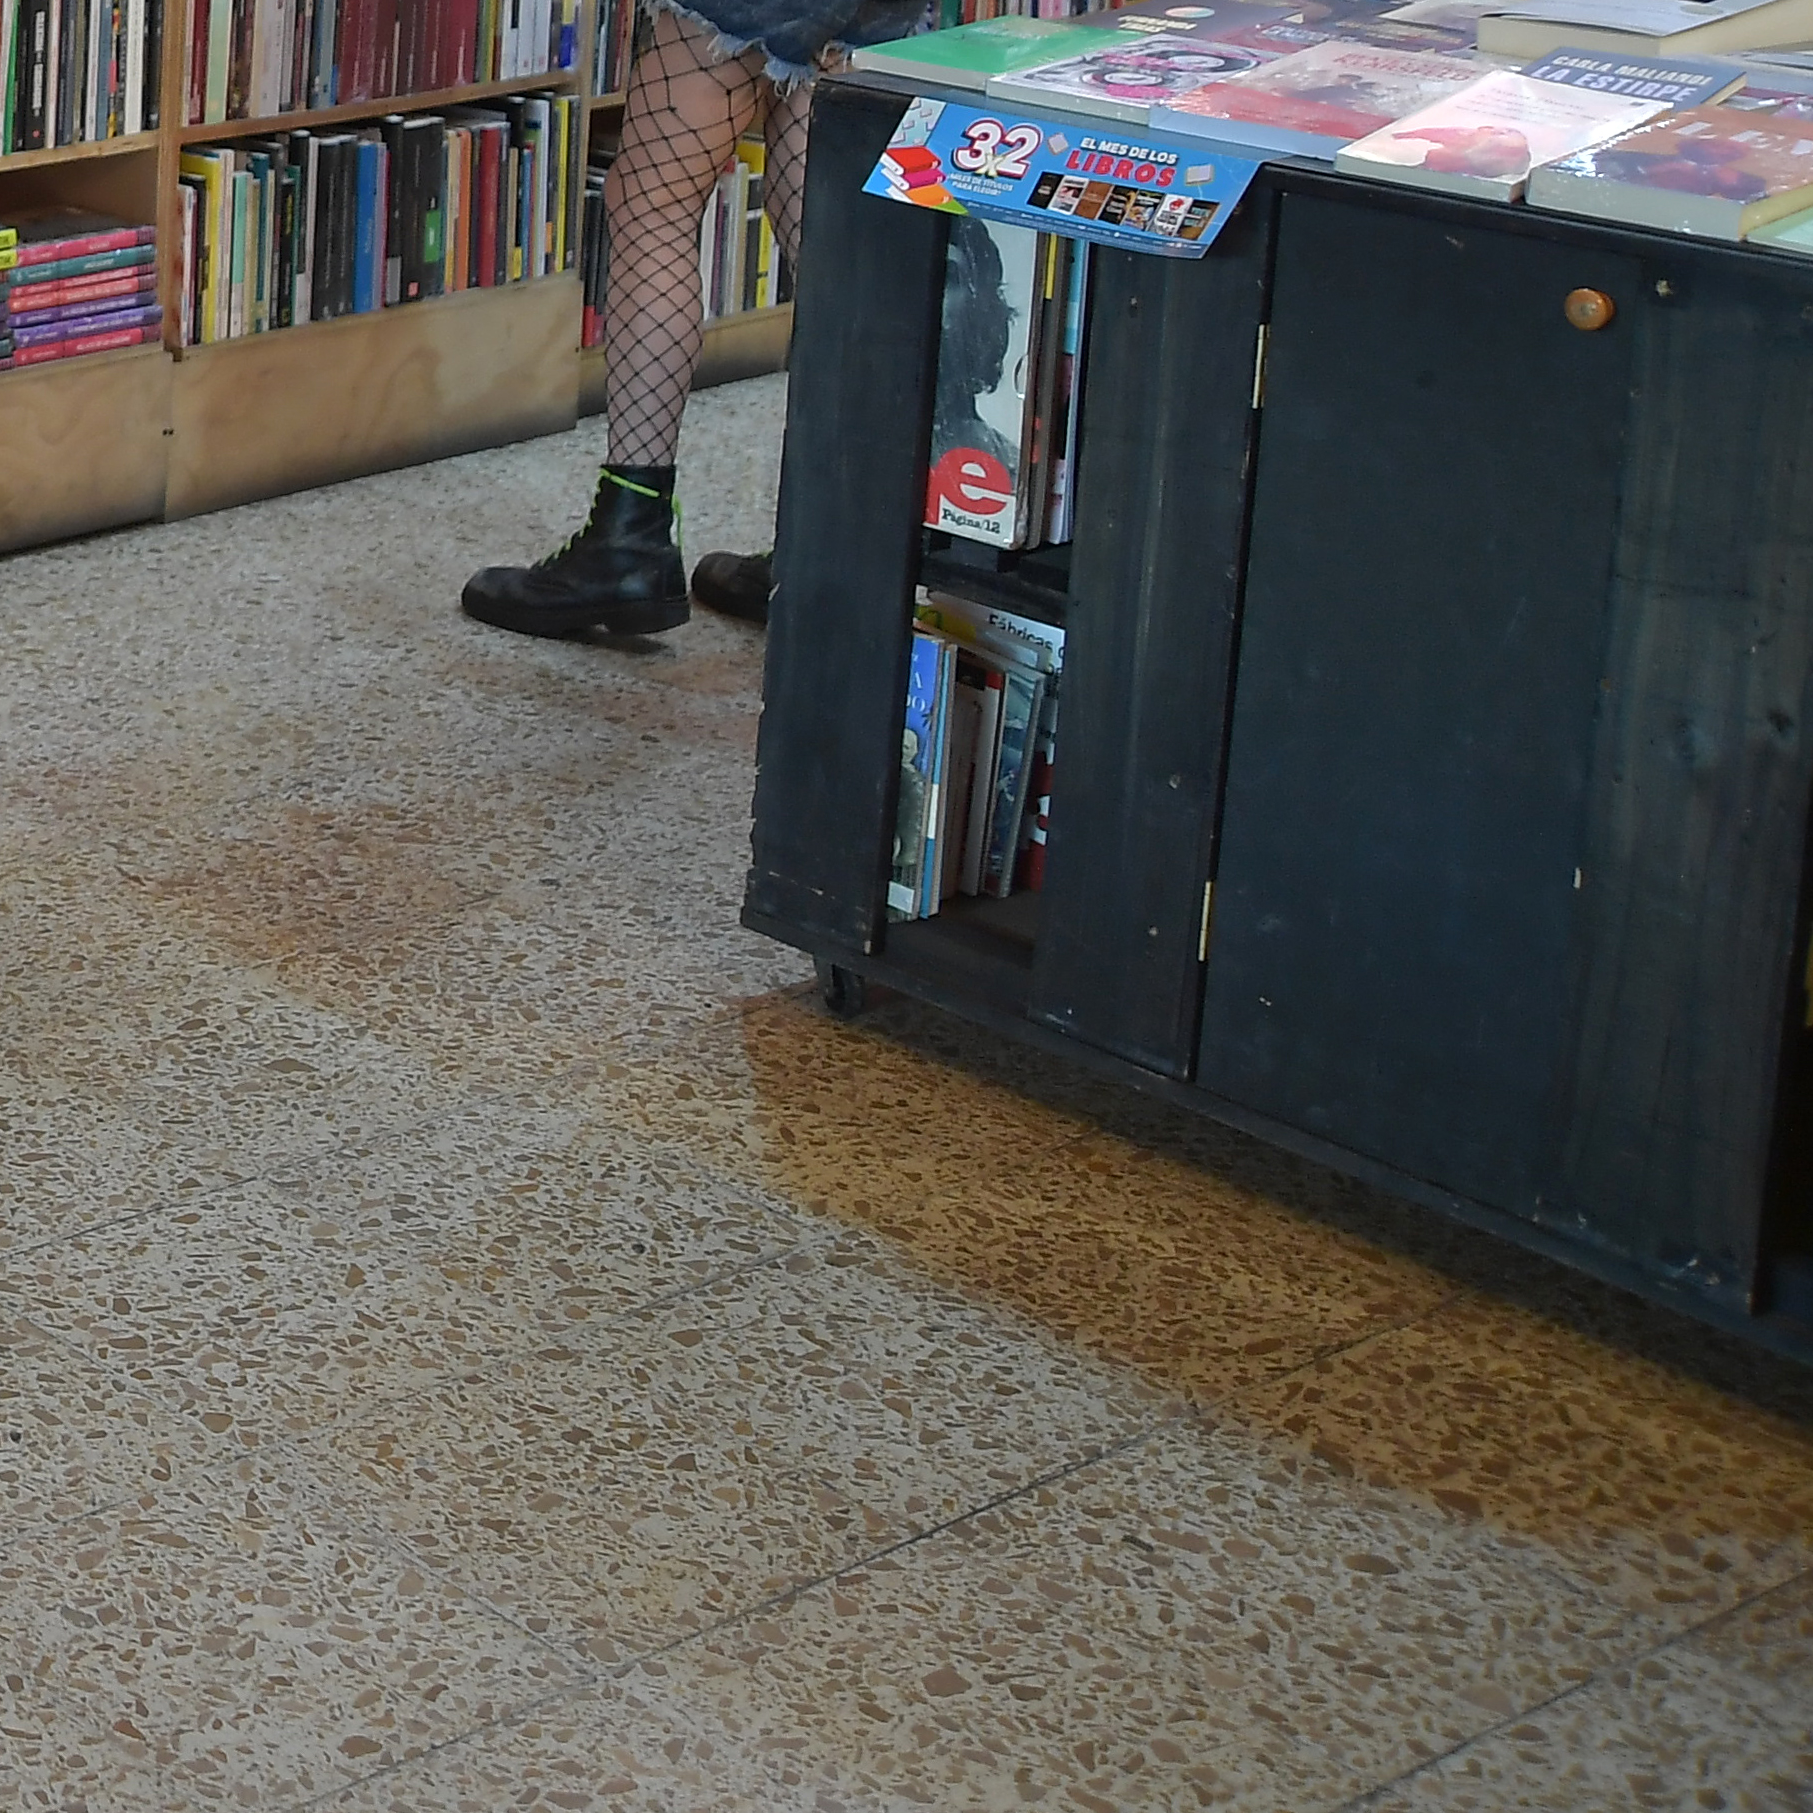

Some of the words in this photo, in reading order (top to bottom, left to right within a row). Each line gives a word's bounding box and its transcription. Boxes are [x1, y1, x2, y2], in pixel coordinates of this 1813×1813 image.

[1529, 65, 1568, 84] LA
[1573, 69, 1698, 103] ESTIRPE
[1552, 55, 1614, 76] CARLA
[1065, 150, 1176, 187] LIBROS
[1080, 138, 1097, 150] EL
[1098, 141, 1127, 155] MES
[1130, 146, 1148, 159] DE
[1149, 150, 1178, 164] LOS
[987, 614, 1054, 654] Fábricas
